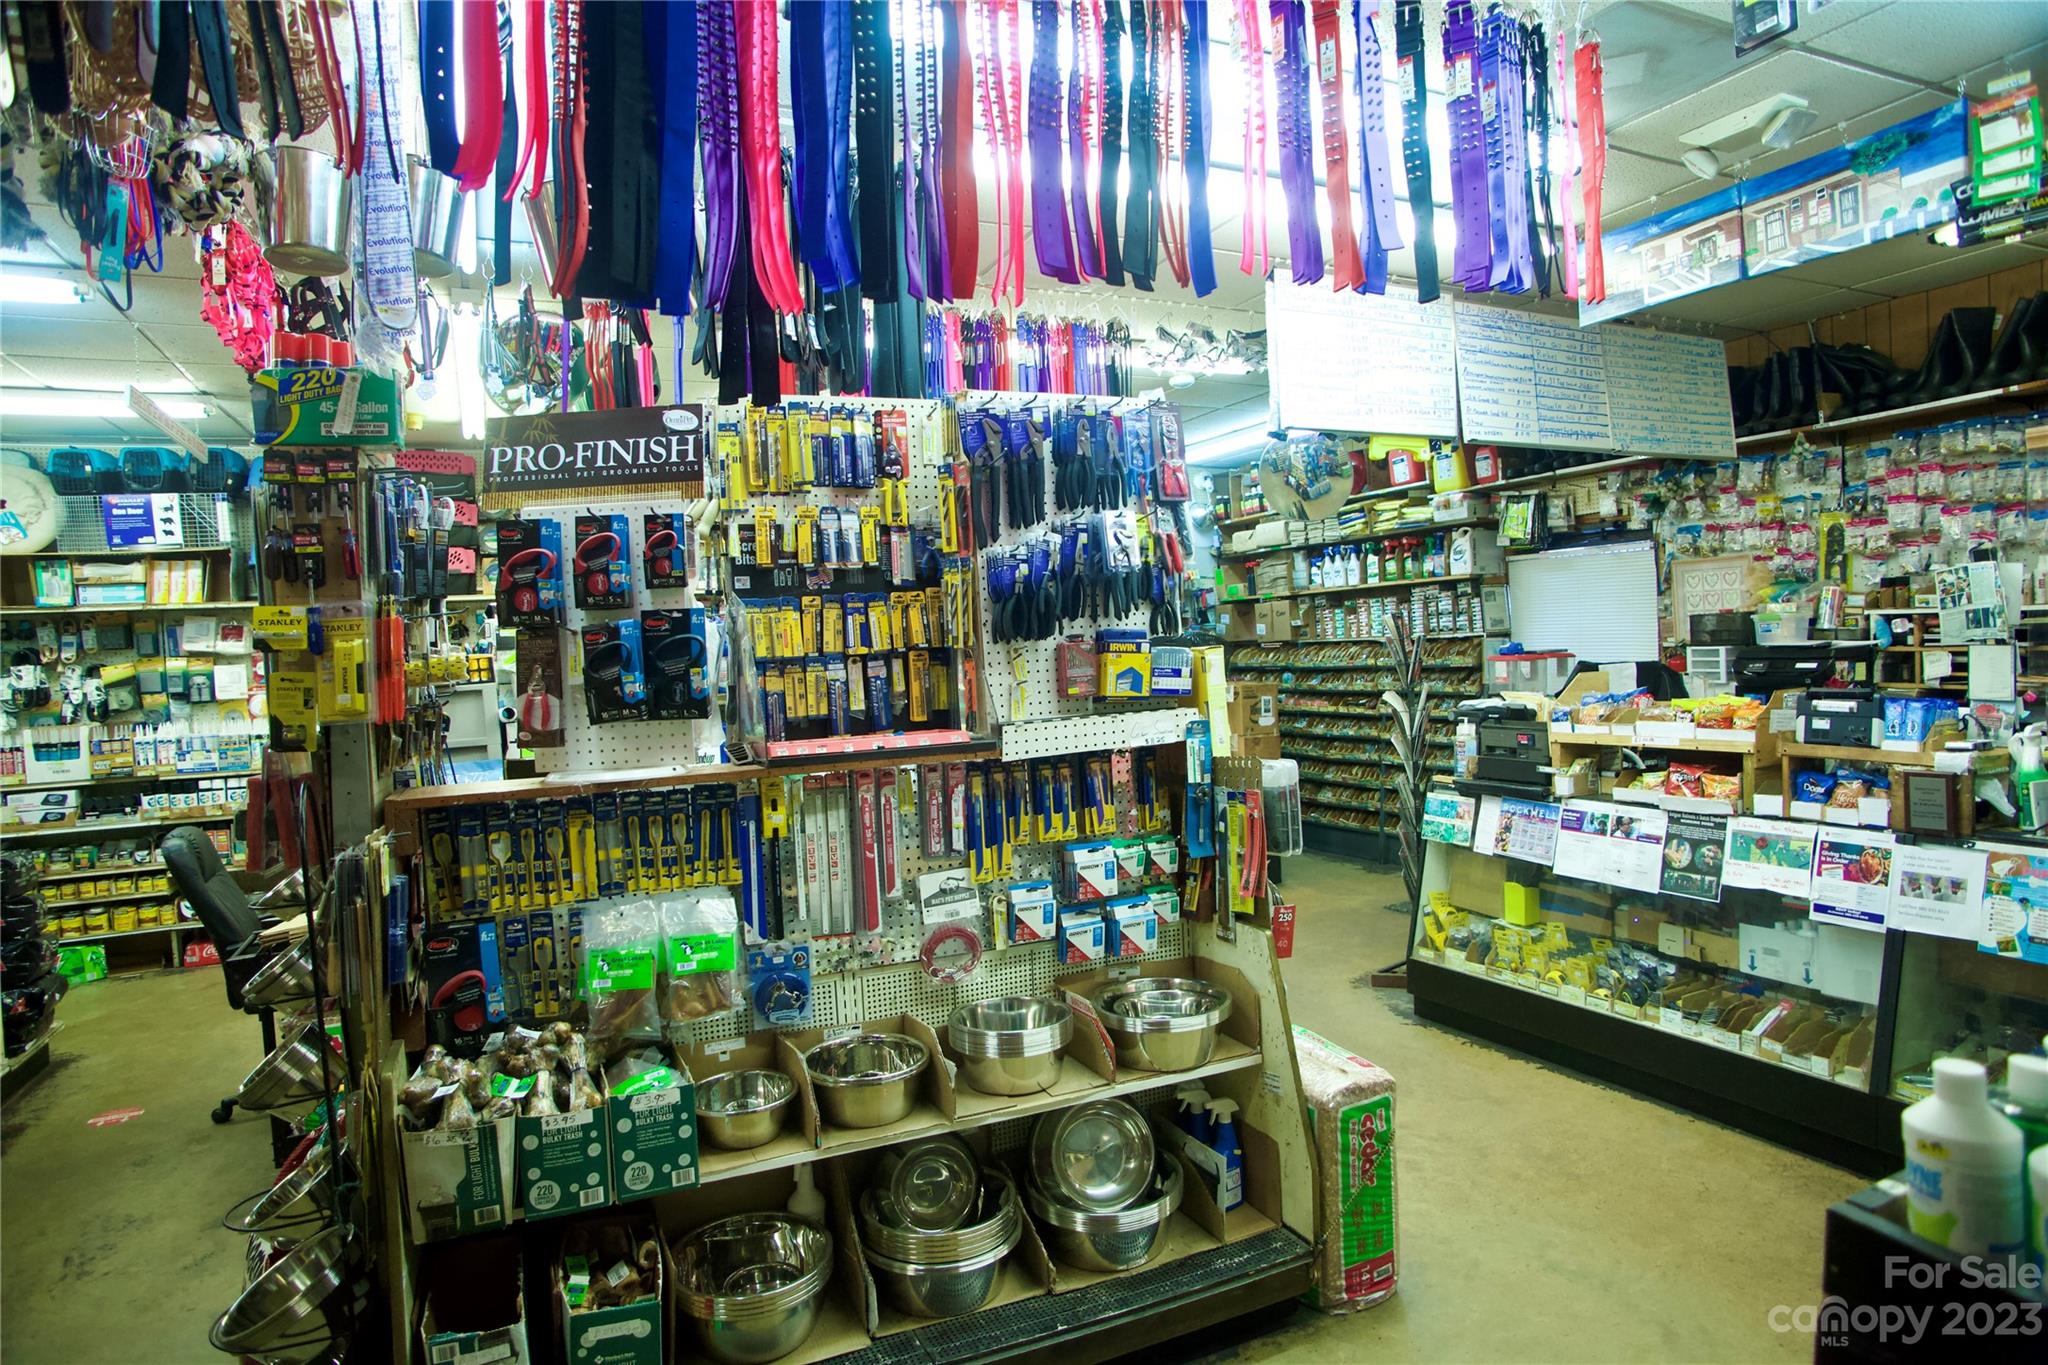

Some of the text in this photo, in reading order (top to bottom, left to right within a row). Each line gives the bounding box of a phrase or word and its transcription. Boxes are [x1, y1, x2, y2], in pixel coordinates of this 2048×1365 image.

[366, 203, 408, 214] Evolution
[367, 236, 410, 248] Evolution
[368, 264, 412, 277] Evolution
[291, 368, 336, 393] 220
[280, 384, 343, 404] LIGHT DUTY BAG
[490, 434, 697, 474] PRO-FINISH
[489, 464, 699, 483] PROFESSIONAL PET GROOMING TOOLS
[258, 619, 302, 627] STANLEY
[324, 623, 362, 633] TANLEY
[1109, 643, 1137, 652] IRWIN
[1503, 803, 1559, 819] ROCKWELL
[1821, 850, 1860, 860] Giving Thanks
[1079, 863, 1100, 871] ARROW
[1017, 905, 1038, 913] ARROW
[1278, 913, 1293, 922] 250
[1122, 921, 1142, 929] ARROW
[1068, 929, 1088, 937] ARROW
[635, 1113, 675, 1127] BULKY TRASH
[542, 1130, 584, 1145] BULKY TRASH
[472, 1161, 483, 1183] LIGHT
[630, 1165, 647, 1177] 220
[473, 1183, 484, 1201] FOR
[536, 1185, 553, 1196] 220
